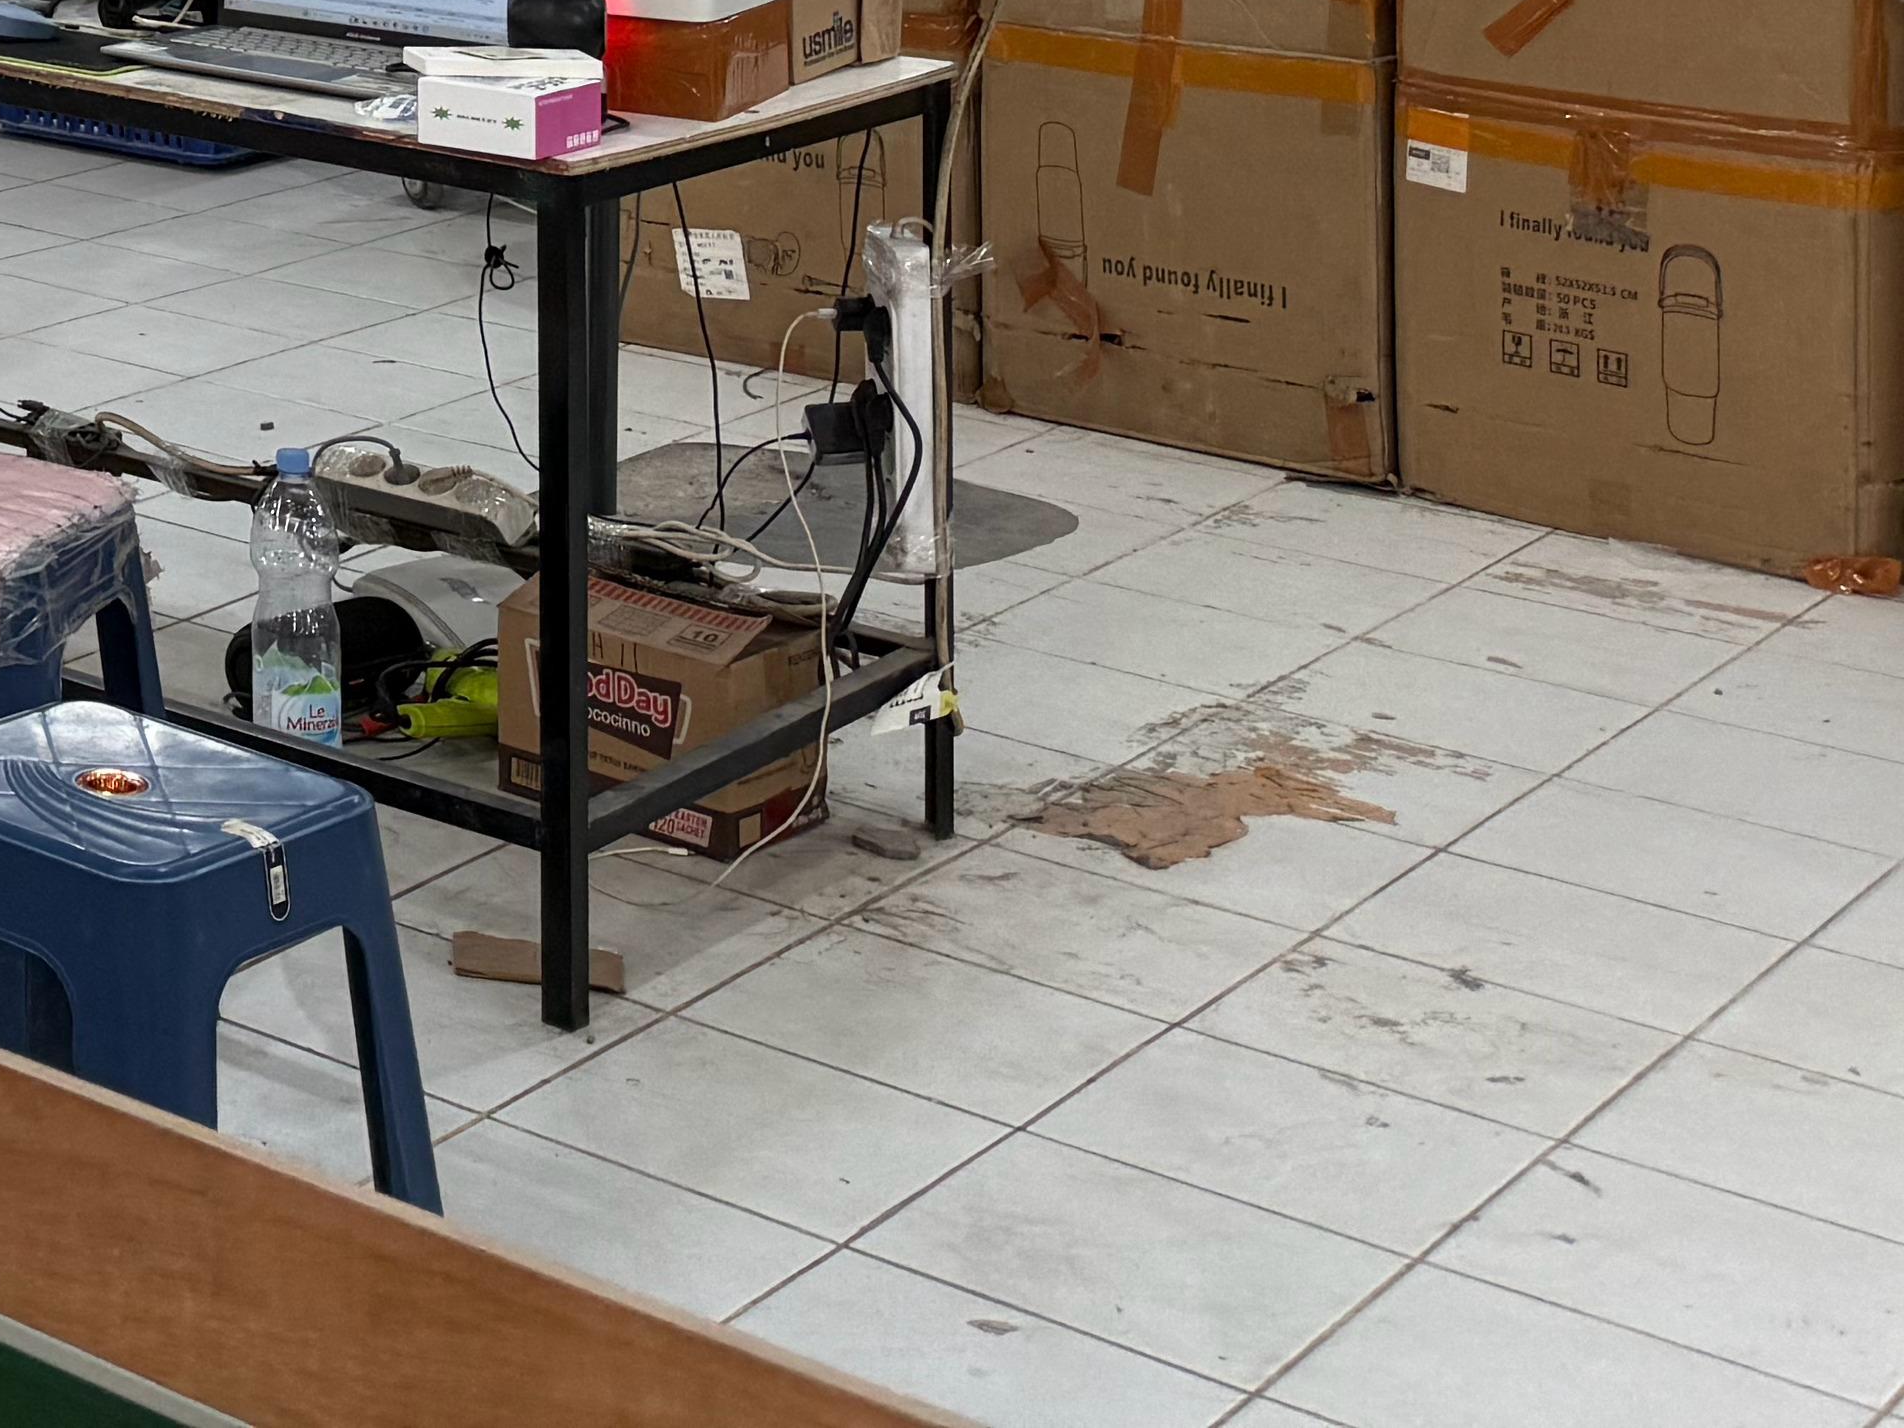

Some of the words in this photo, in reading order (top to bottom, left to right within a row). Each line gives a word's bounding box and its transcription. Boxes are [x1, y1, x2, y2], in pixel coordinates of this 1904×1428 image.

[803, 10, 854, 59] usmile
[793, 149, 825, 172] you
[1500, 209, 1505, 227] I
[1509, 211, 1563, 242] finally
[1102, 256, 1136, 279] you
[1143, 265, 1200, 295] found
[1206, 269, 1275, 307] finally
[1282, 286, 1287, 309] I
[1556, 292, 1571, 305] 50
[1573, 295, 1597, 311] PCS
[1620, 288, 1639, 301] CM
[693, 628, 719, 644] 10
[309, 703, 326, 719] Le
[615, 672, 673, 729] Day
